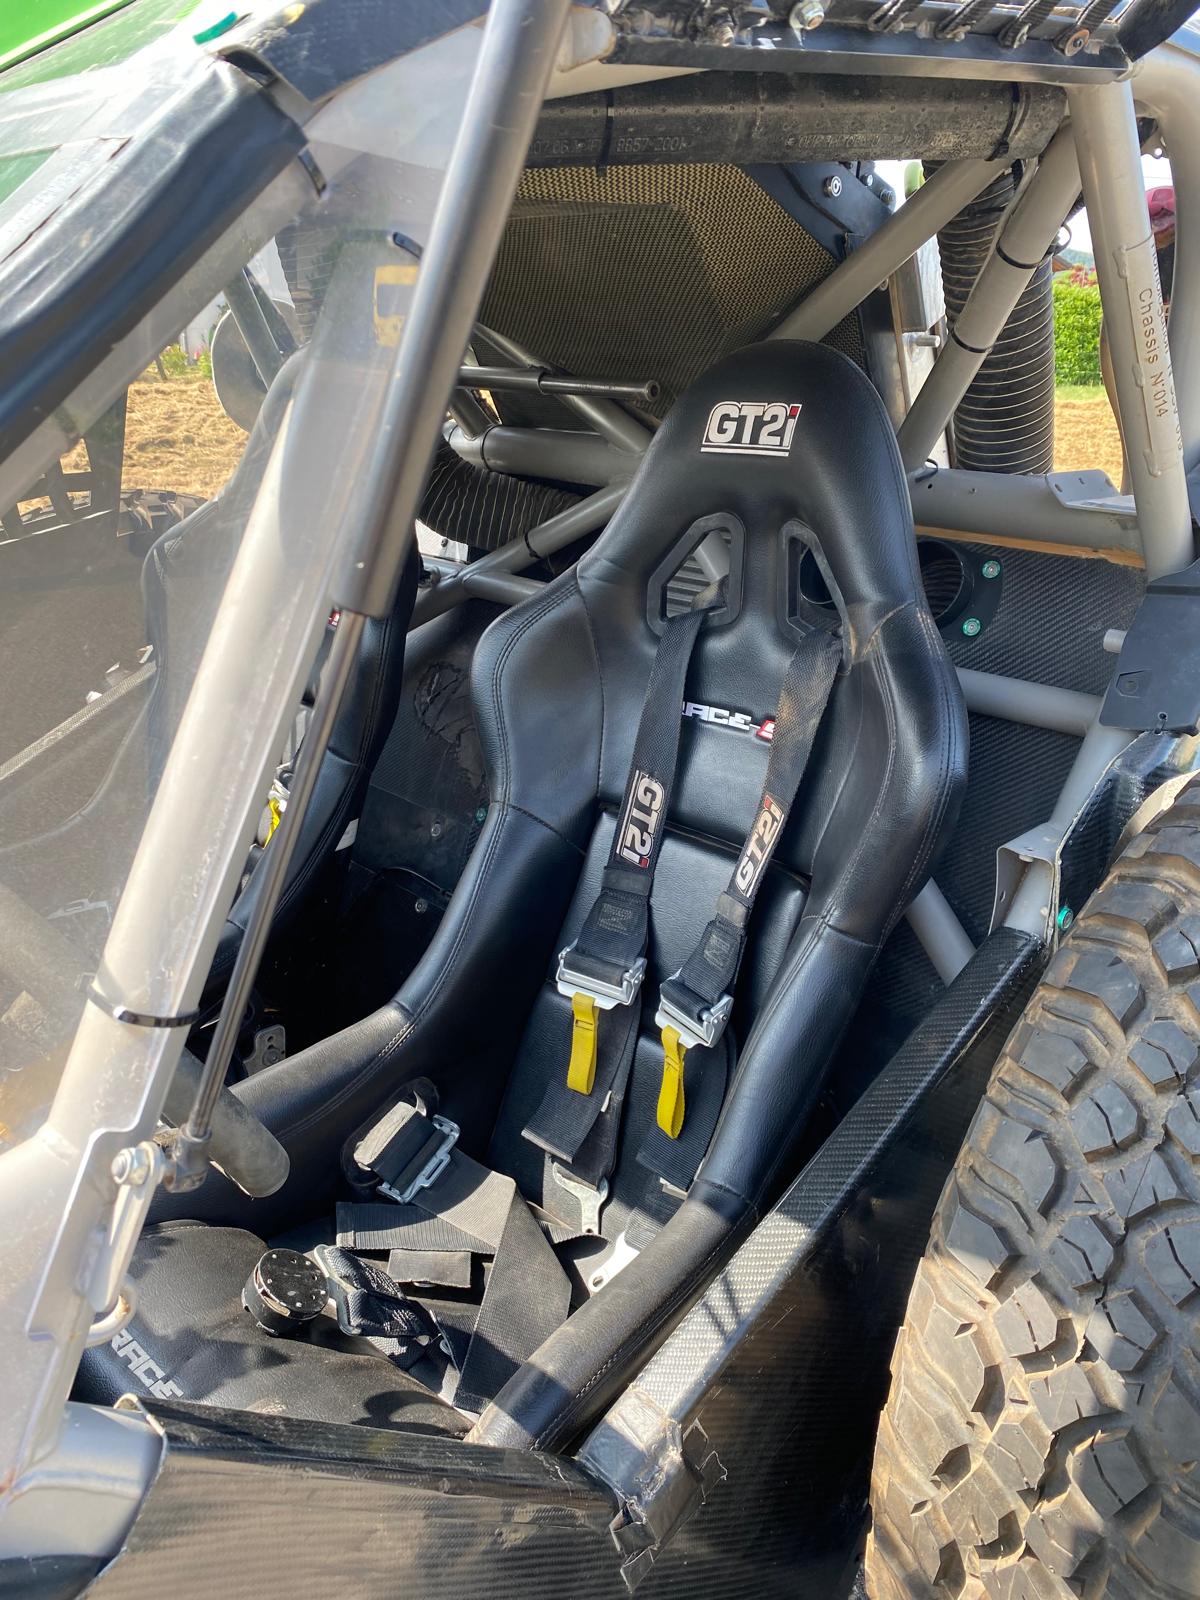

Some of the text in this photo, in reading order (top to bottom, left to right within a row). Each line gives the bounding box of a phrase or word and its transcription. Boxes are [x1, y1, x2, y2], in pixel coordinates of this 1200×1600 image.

[1139, 287, 1160, 364] Chassis
[702, 401, 802, 450] GT2i
[620, 771, 665, 868] GT2i
[735, 794, 783, 896] GT2i
[111, 1328, 184, 1400] RACE
